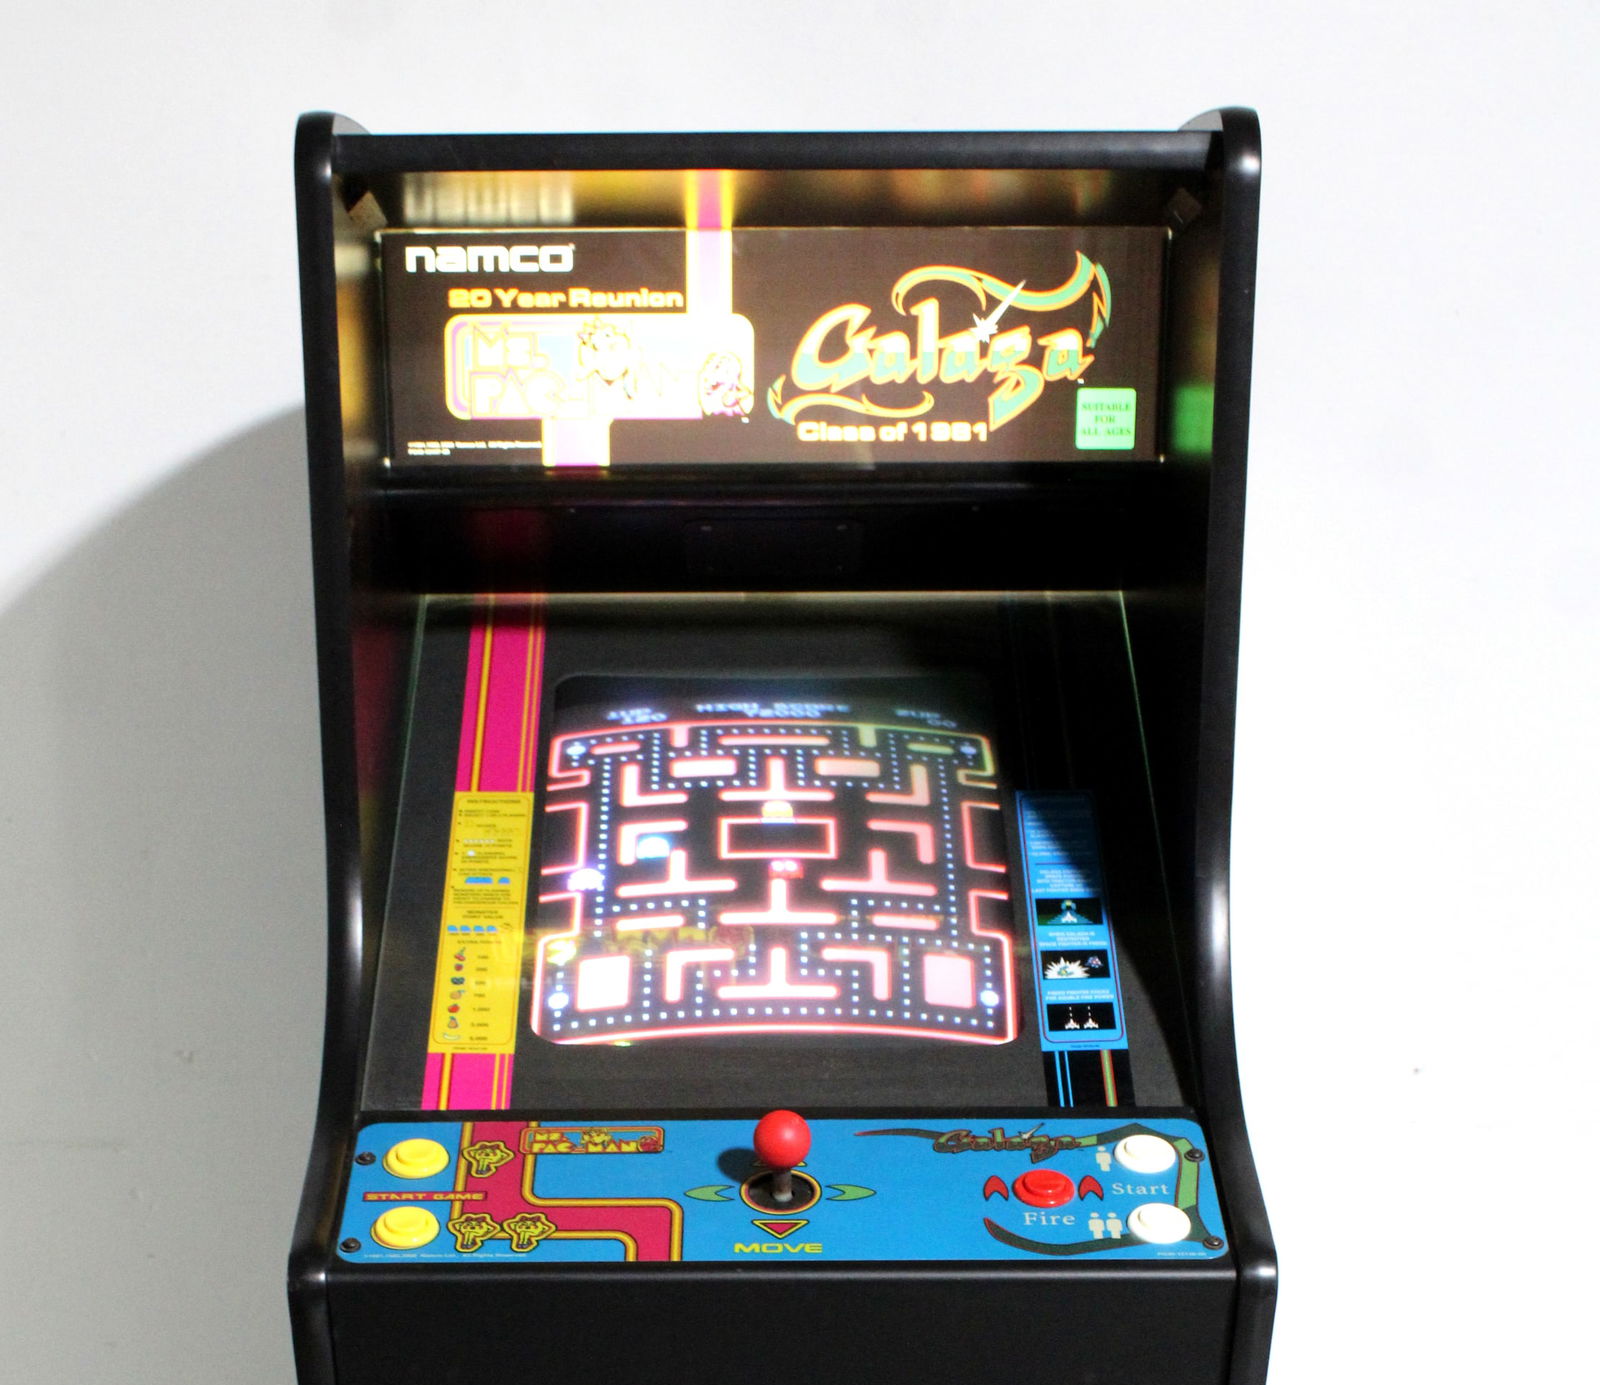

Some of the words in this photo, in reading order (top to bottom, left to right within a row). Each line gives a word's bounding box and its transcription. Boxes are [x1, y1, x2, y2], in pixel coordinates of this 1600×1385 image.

[405, 244, 573, 272] namco
[495, 288, 566, 308] Year
[568, 287, 683, 308] Reunion
[791, 297, 1095, 431] Galaga
[1095, 415, 1116, 424] FOR
[797, 421, 876, 442] Class
[878, 421, 908, 442] of
[911, 421, 988, 442] 1981
[1081, 427, 1099, 436] ALL
[1112, 1183, 1170, 1195] Start
[365, 1192, 427, 1201] START
[1023, 1212, 1076, 1225] Fire
[734, 1243, 823, 1253] MOVE
